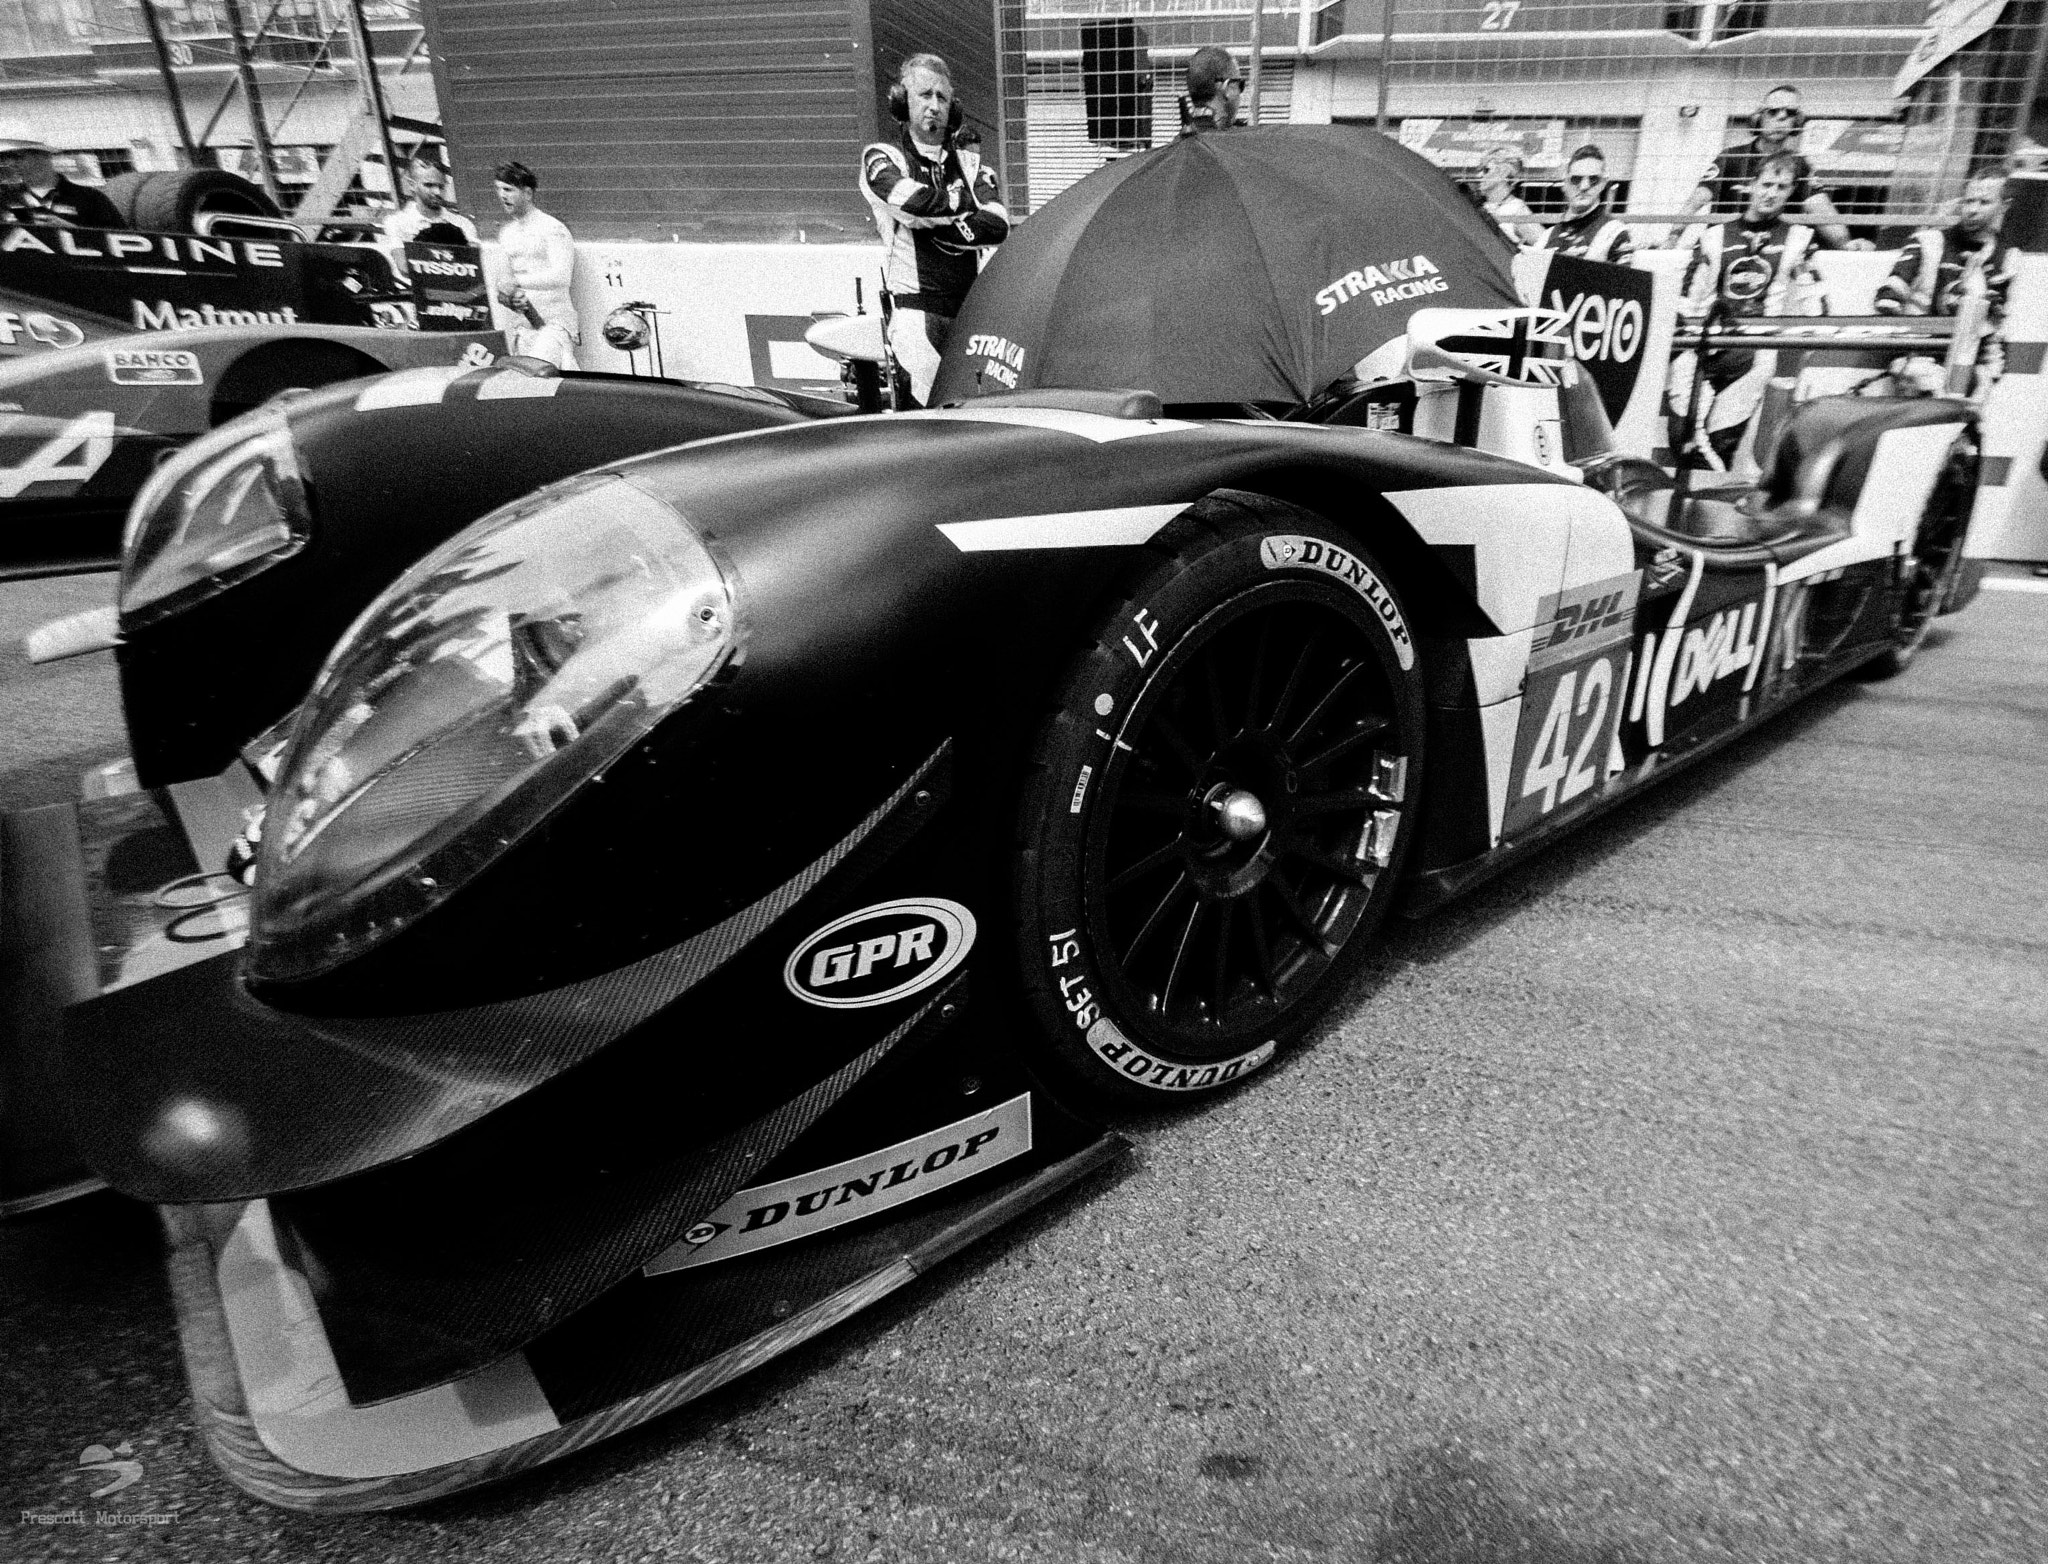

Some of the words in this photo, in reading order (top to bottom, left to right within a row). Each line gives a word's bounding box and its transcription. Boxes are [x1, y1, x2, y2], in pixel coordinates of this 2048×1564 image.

[1481, 1, 1521, 30] 27
[0, 227, 284, 268] ALPINE
[408, 259, 479, 278] TISSOT
[605, 273, 623, 288] 11
[1370, 276, 1450, 307] RACING
[132, 299, 298, 331] Matmut
[984, 358, 1019, 390] RACING
[1298, 540, 1409, 645] DUNLOP
[1122, 608, 1159, 669] LF
[1546, 590, 1624, 649] DHL
[1521, 657, 1613, 815] 42
[809, 923, 936, 987] GPR
[1060, 975, 1101, 1030] SET
[1100, 1042, 1246, 1088] DUNLOP
[739, 1126, 1001, 1235] DUNLOP
